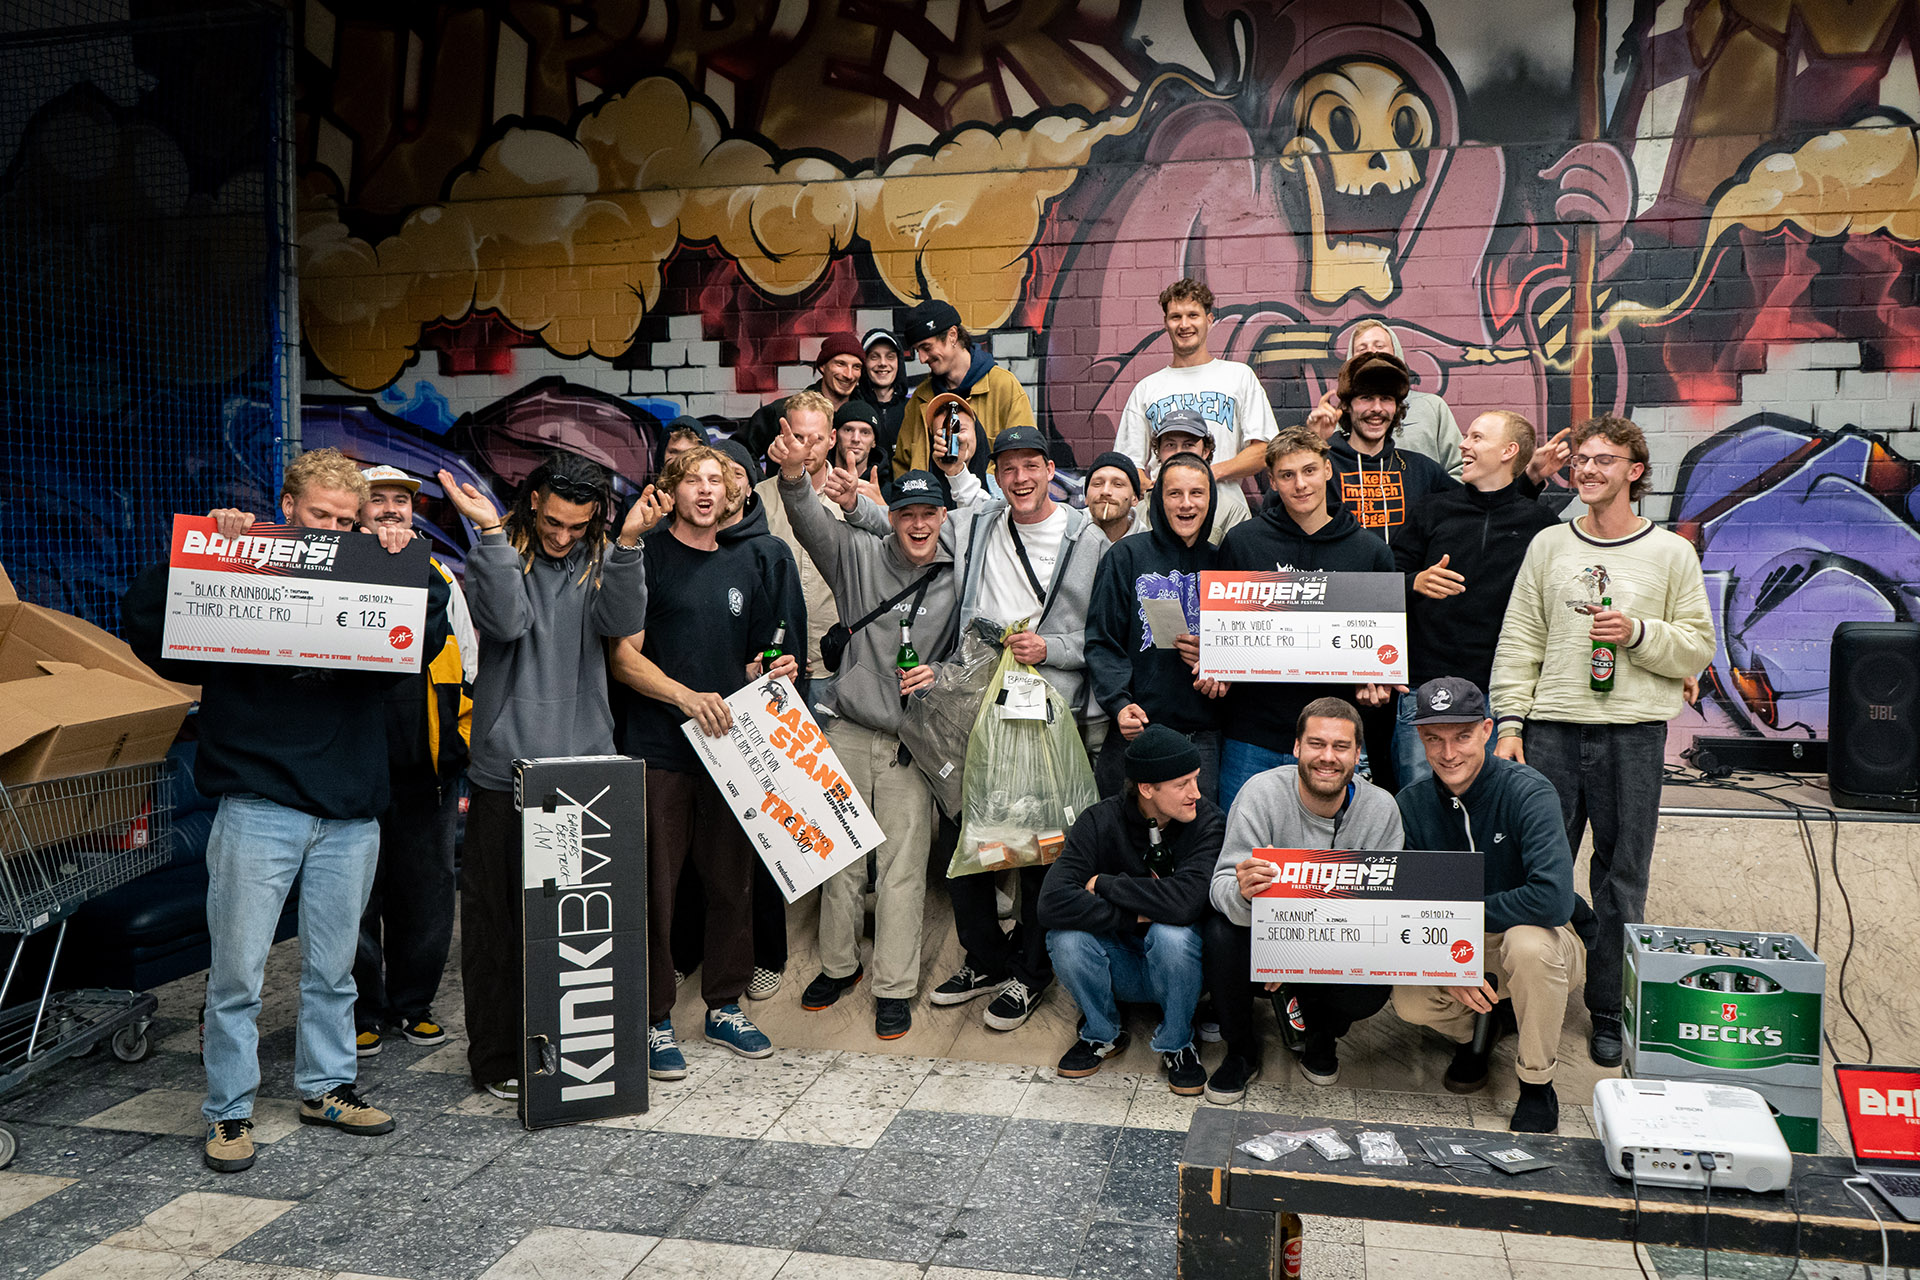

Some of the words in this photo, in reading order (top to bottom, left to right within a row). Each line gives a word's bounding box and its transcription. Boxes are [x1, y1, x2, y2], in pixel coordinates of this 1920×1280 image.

[1363, 474, 1390, 484] ken
[1346, 486, 1398, 497] mensch
[218, 556, 253, 565] FREESTYLE
[304, 564, 332, 572] FESTIVAL
[186, 602, 223, 617] THIRD
[230, 604, 263, 620] PLACE
[270, 606, 291, 621] PRO
[336, 611, 348, 627] €
[360, 610, 387, 628] 125
[1232, 620, 1246, 631] BMX
[1216, 636, 1239, 646] FIRST
[1244, 636, 1272, 646] PLACE
[1276, 636, 1294, 646] PRO
[1332, 636, 1341, 648] €
[1350, 634, 1374, 648] 500
[231, 646, 270, 656] freedombmx
[356, 654, 393, 663] freedombmx
[1868, 704, 1897, 720] JBL
[737, 712, 766, 747] SKETCHY
[761, 748, 781, 773] KEVIN
[737, 740, 754, 757] BMX
[748, 756, 765, 776] BEST
[760, 774, 777, 796] TRICK
[769, 726, 852, 801] STAND
[726, 780, 740, 798] VANS
[828, 788, 840, 798] AT
[836, 798, 848, 814] THE
[836, 783, 850, 800] BMX
[846, 801, 860, 818] JAM
[784, 816, 797, 828] €
[823, 791, 862, 850] ZUPPERMARKET
[533, 822, 554, 850] AM
[556, 824, 568, 850] BEST
[758, 832, 772, 850] éclat
[792, 830, 814, 854] 300
[558, 853, 570, 886] TRICK
[774, 860, 796, 894] freedombmx
[1268, 926, 1304, 940] SECOND
[1308, 928, 1336, 941] PLACE
[1340, 928, 1360, 942] PRO
[1400, 928, 1411, 944] €
[1422, 926, 1448, 944] 300
[1678, 1022, 1782, 1046] BECK'S
